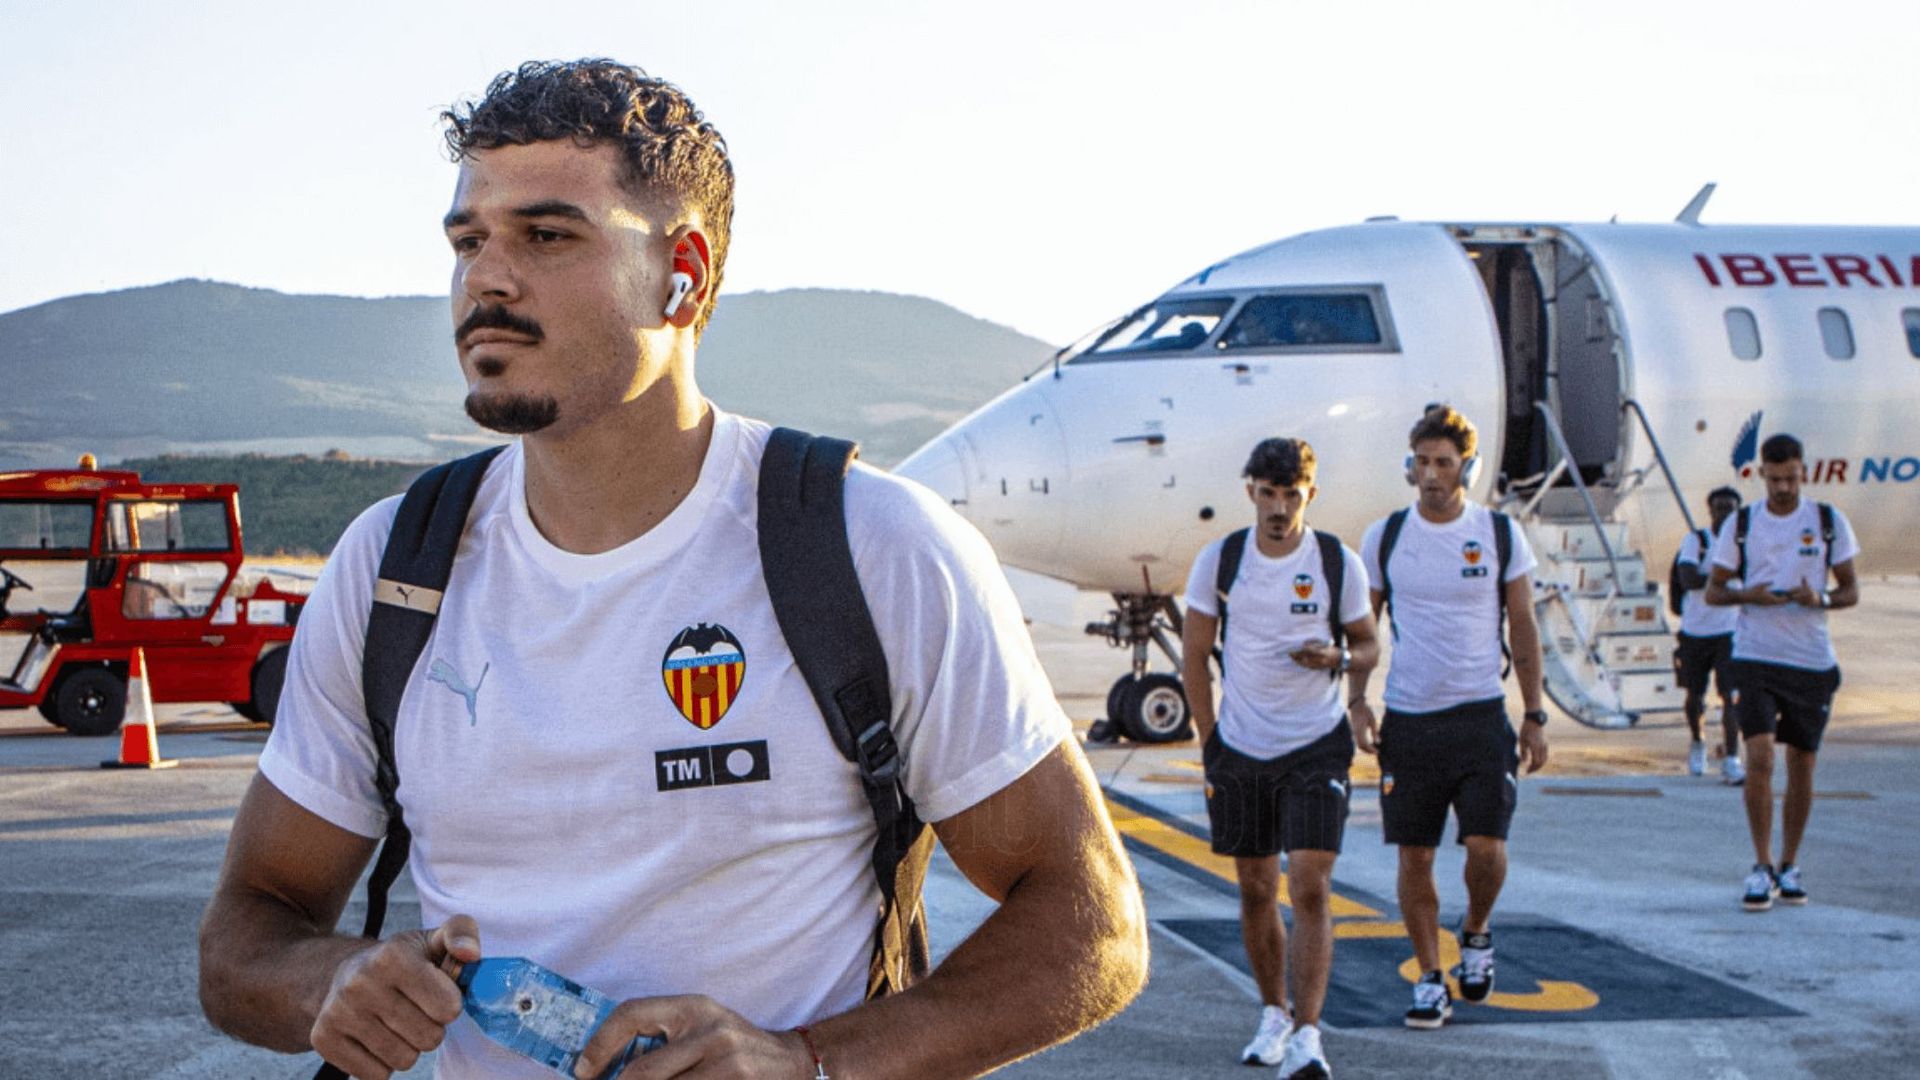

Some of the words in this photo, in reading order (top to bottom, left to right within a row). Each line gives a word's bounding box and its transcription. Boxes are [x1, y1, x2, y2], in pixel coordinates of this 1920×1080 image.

[1694, 253, 1920, 288] IBERI
[1801, 458, 1848, 484] IR
[662, 757, 702, 783] TM
